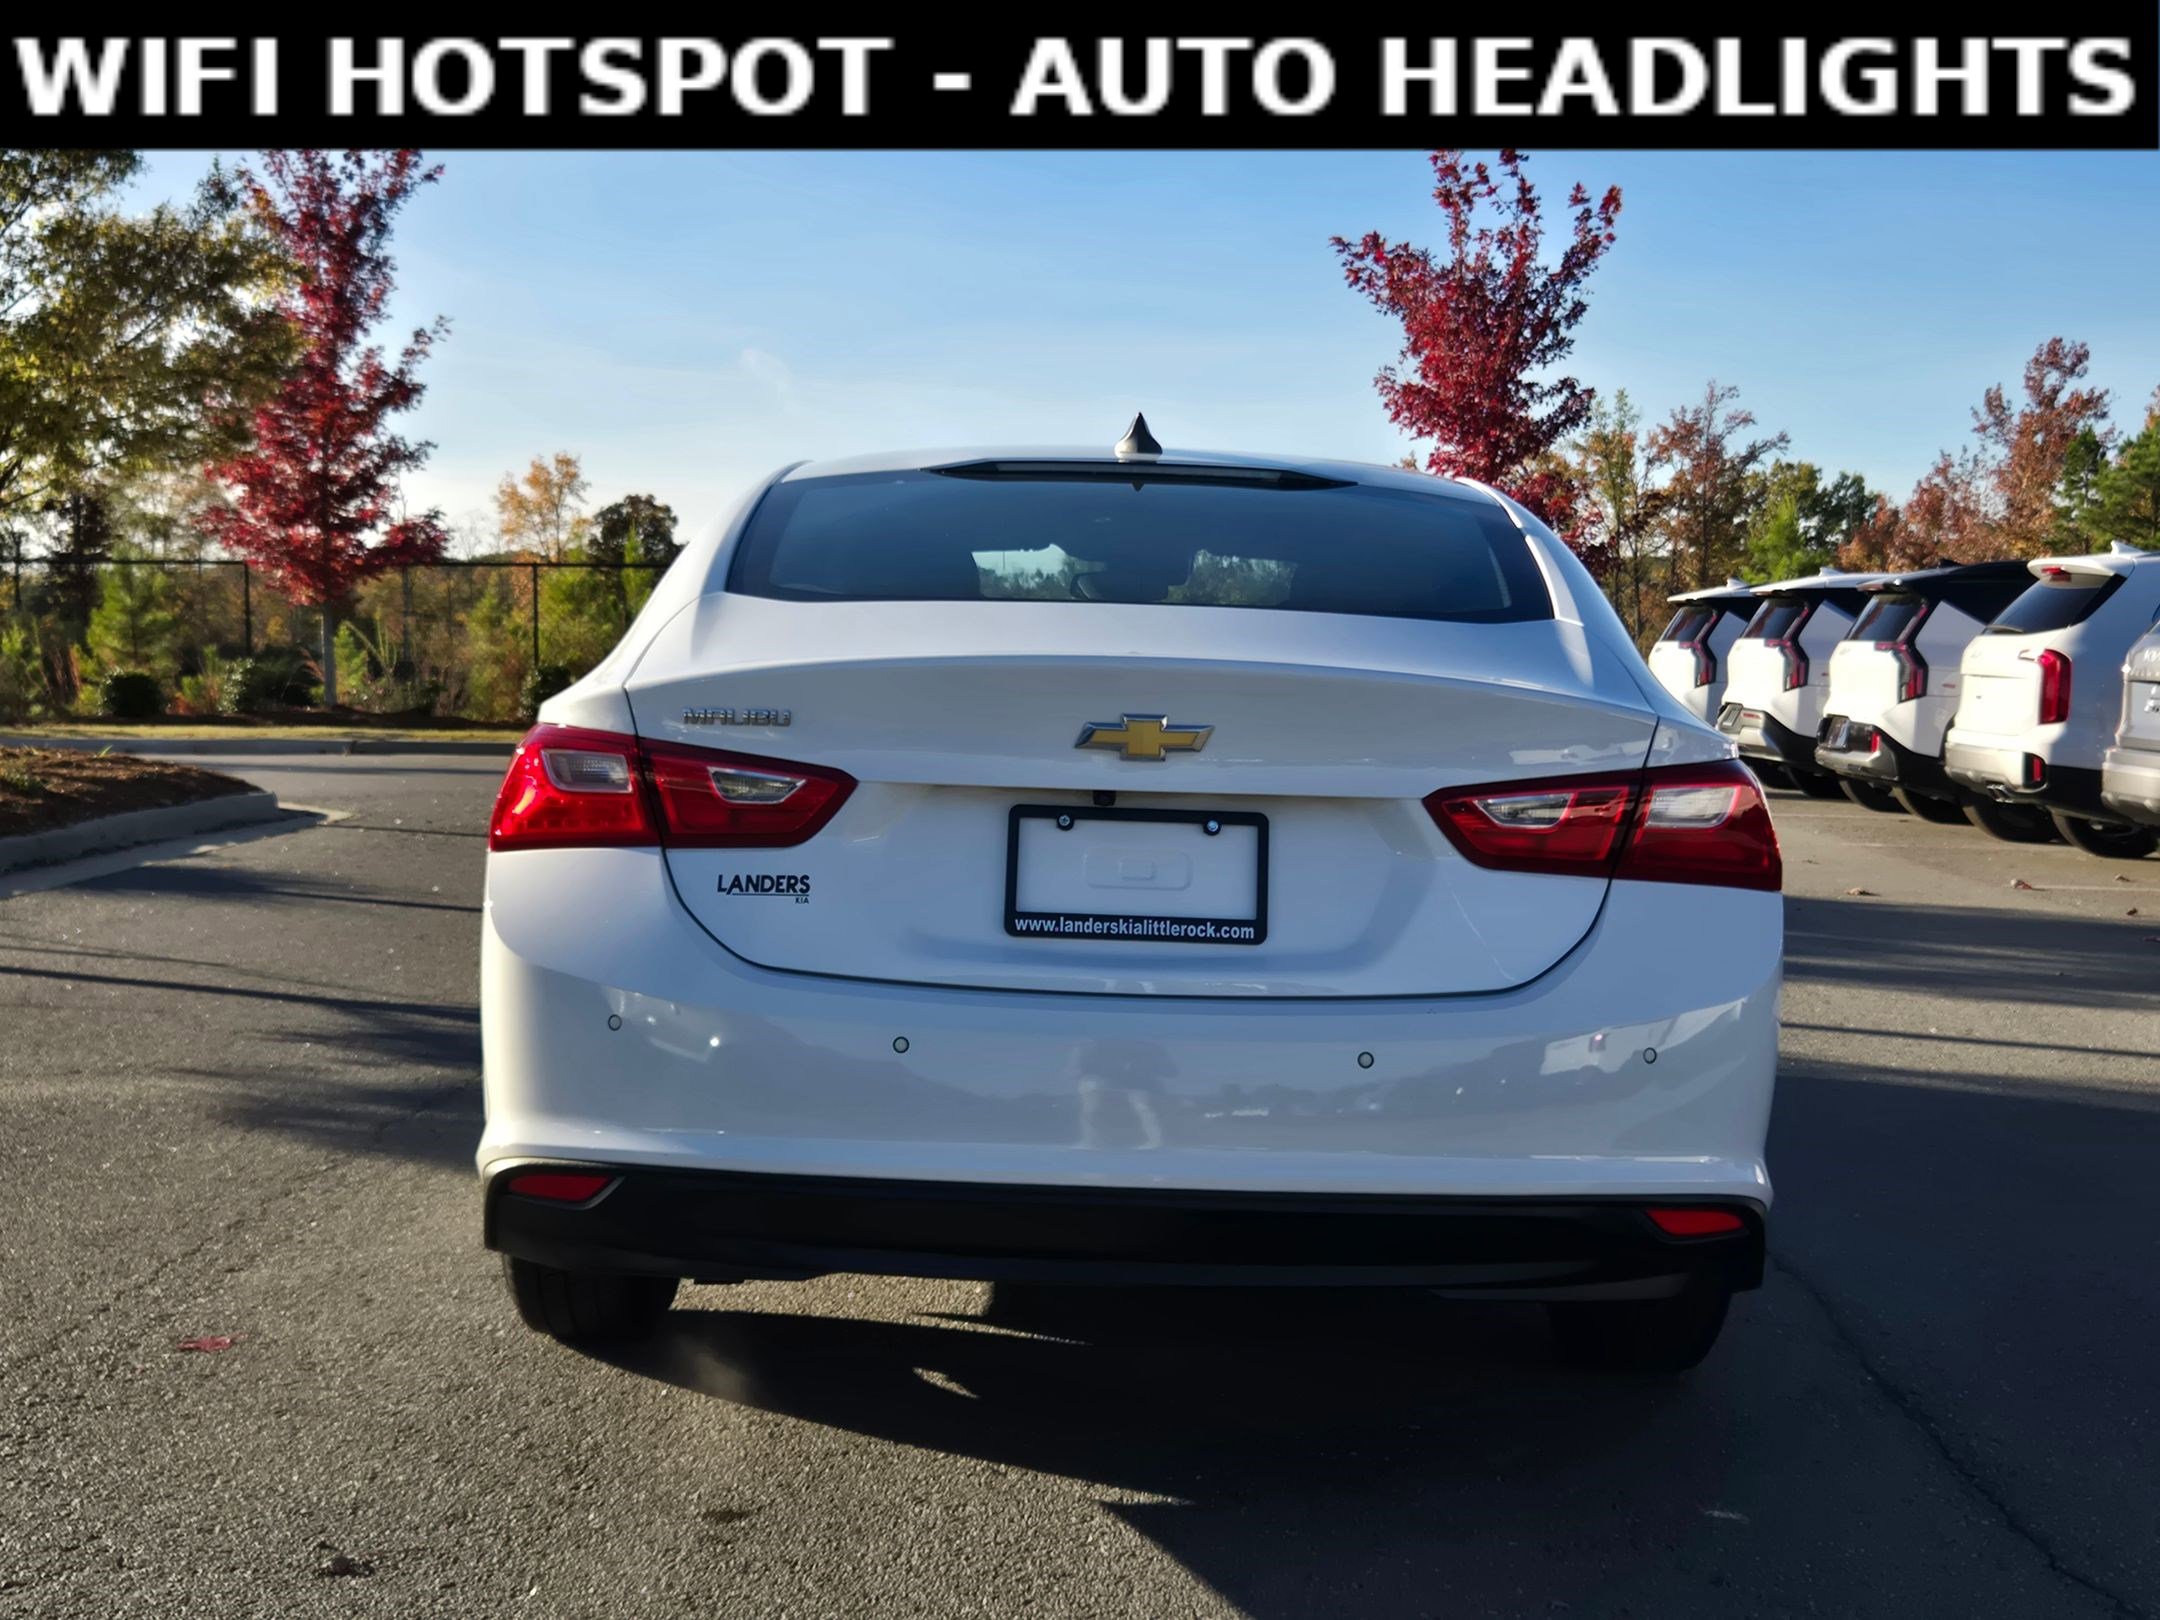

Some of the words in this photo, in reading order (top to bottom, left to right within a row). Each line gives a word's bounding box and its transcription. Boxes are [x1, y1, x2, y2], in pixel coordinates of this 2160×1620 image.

[682, 708, 792, 727] MALIBU
[717, 874, 811, 895] LANDERS
[1014, 916, 1255, 939] www.landerskialittlerock.com
